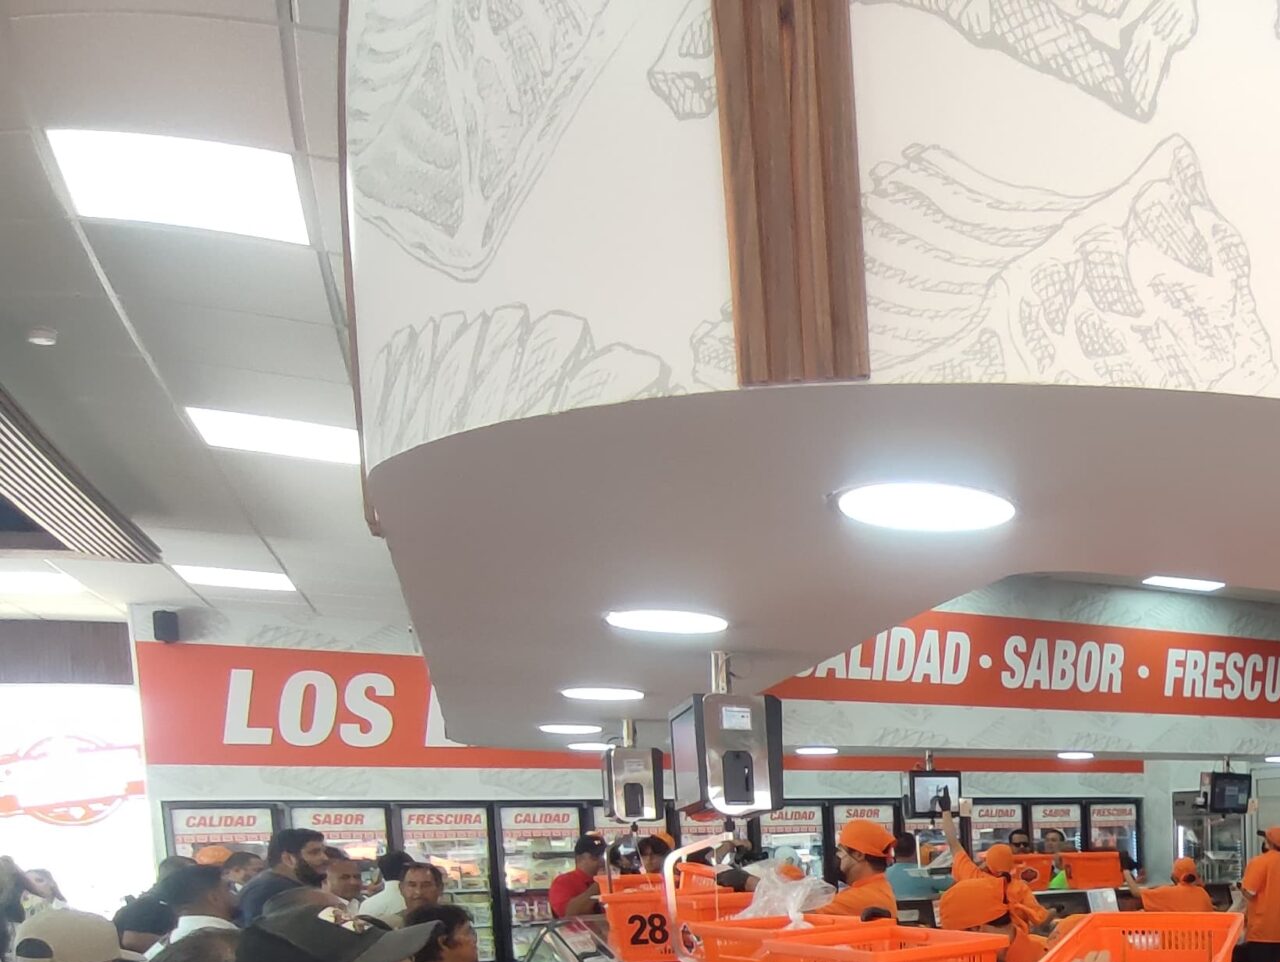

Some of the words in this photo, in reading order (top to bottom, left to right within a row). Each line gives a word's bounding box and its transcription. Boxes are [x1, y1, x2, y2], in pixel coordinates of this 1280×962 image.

[796, 626, 971, 685] ALIDAD
[1001, 635, 1125, 694] SABOR
[223, 669, 395, 747] LOS
[312, 813, 365, 826] SABOR
[407, 813, 482, 826] FRESCURA
[514, 813, 571, 825] CALIDAD
[770, 811, 816, 822] CALIDAD
[846, 808, 881, 819] SABOR
[978, 808, 1016, 818] CALIDAD
[1042, 808, 1071, 818] SABOR
[186, 815, 257, 828] CALIDAD
[628, 913, 669, 945] 28
